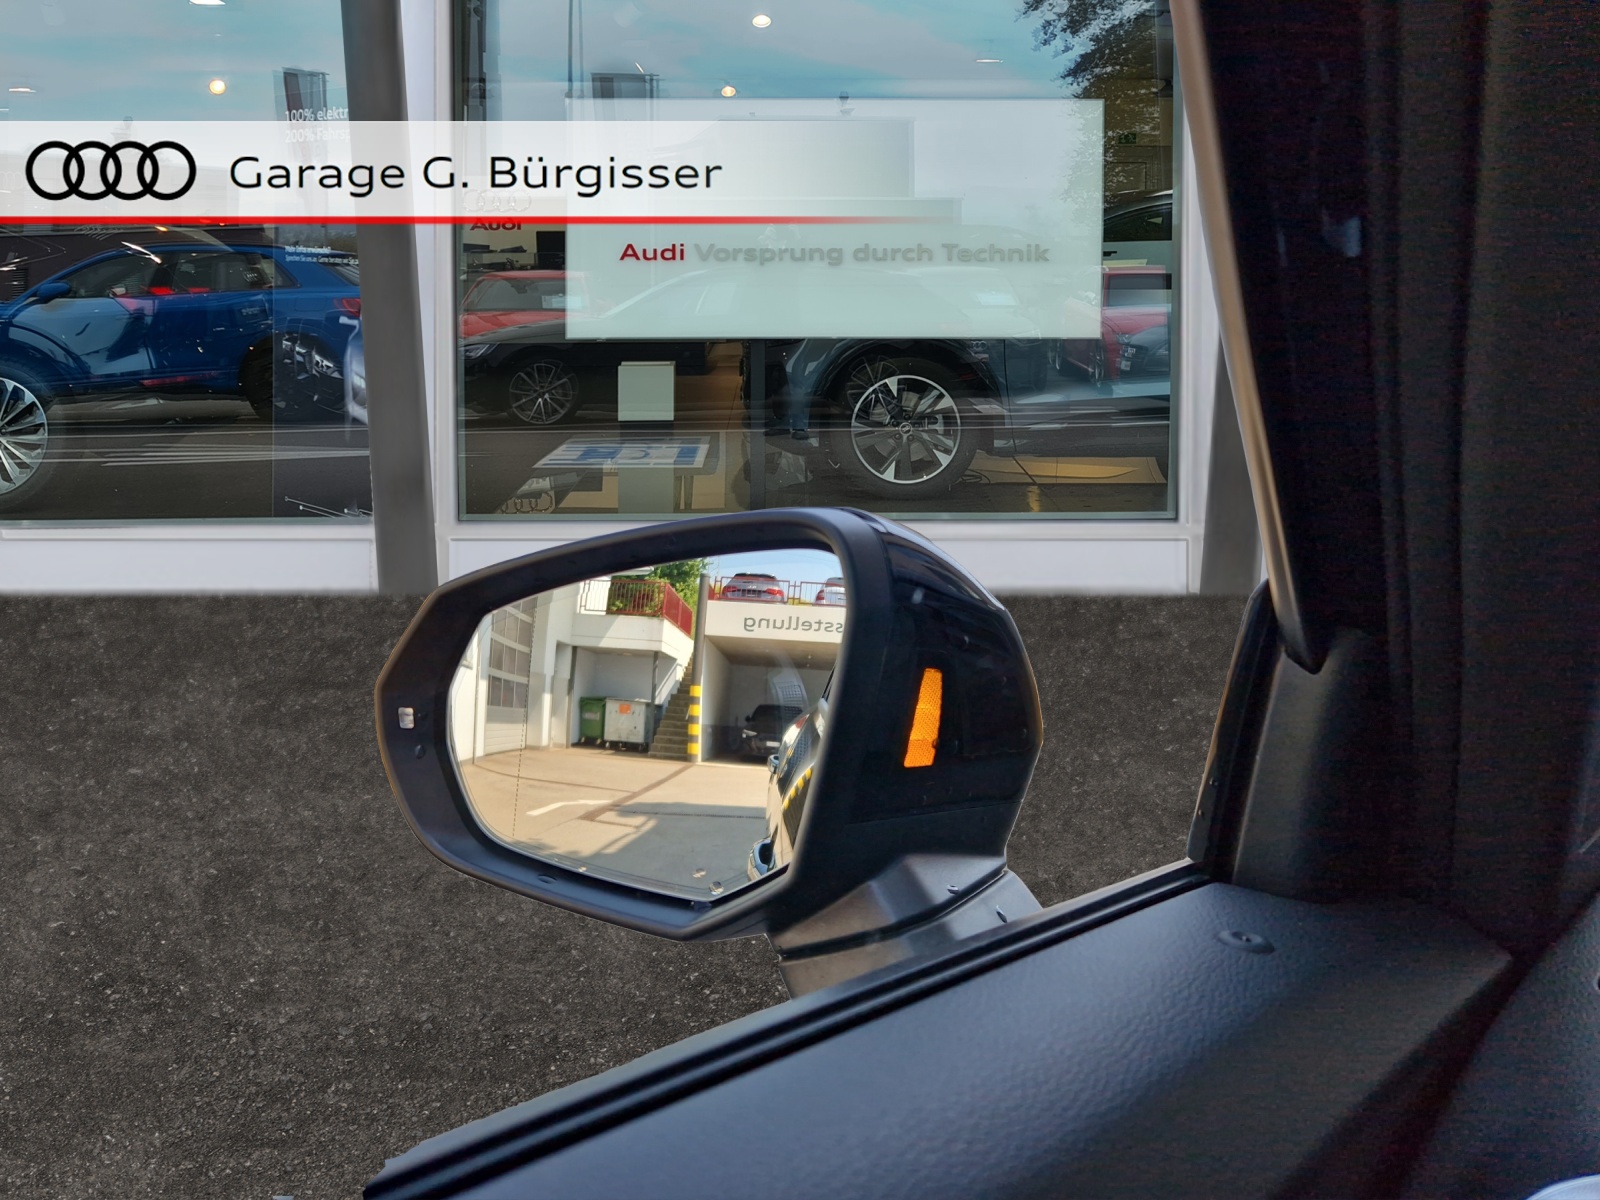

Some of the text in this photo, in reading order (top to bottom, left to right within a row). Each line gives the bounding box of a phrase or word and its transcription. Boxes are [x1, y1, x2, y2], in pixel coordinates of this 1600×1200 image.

[284, 107, 315, 121] 100%
[285, 128, 315, 143] 200%
[470, 217, 522, 231] Audi
[619, 243, 1050, 266] Audi Vorsprung durch Technik
